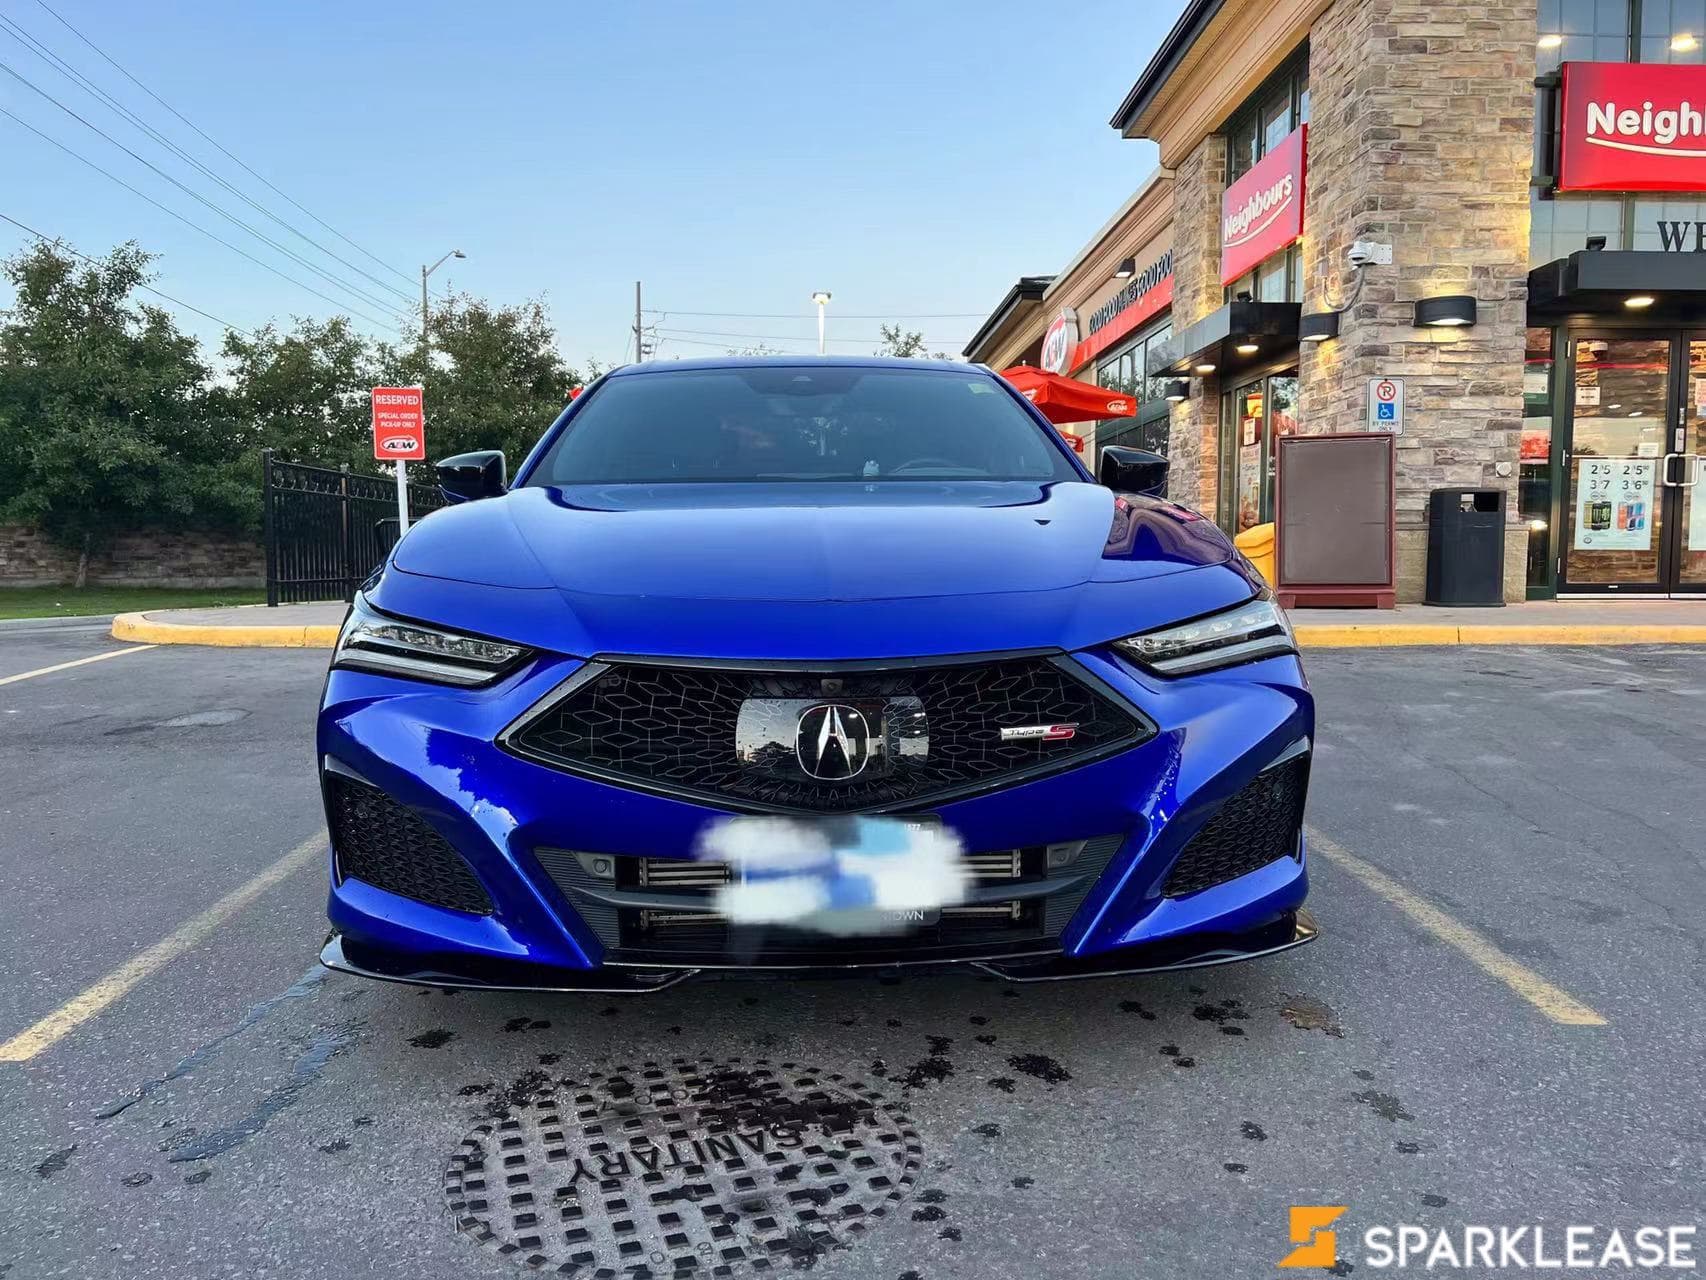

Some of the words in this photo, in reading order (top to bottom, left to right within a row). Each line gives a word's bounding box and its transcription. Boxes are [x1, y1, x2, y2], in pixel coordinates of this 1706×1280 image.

[1586, 101, 1706, 144] Neigh
[1225, 174, 1293, 242] Neighbours
[375, 395, 419, 405] RESERVED
[378, 411, 399, 419] SPECIAL
[386, 441, 415, 449] A&W
[1591, 464, 1598, 475] 2
[1623, 465, 1630, 475] 2
[1590, 480, 1597, 490] 3
[1622, 480, 1629, 490] 3
[569, 1127, 802, 1185] SANITARY
